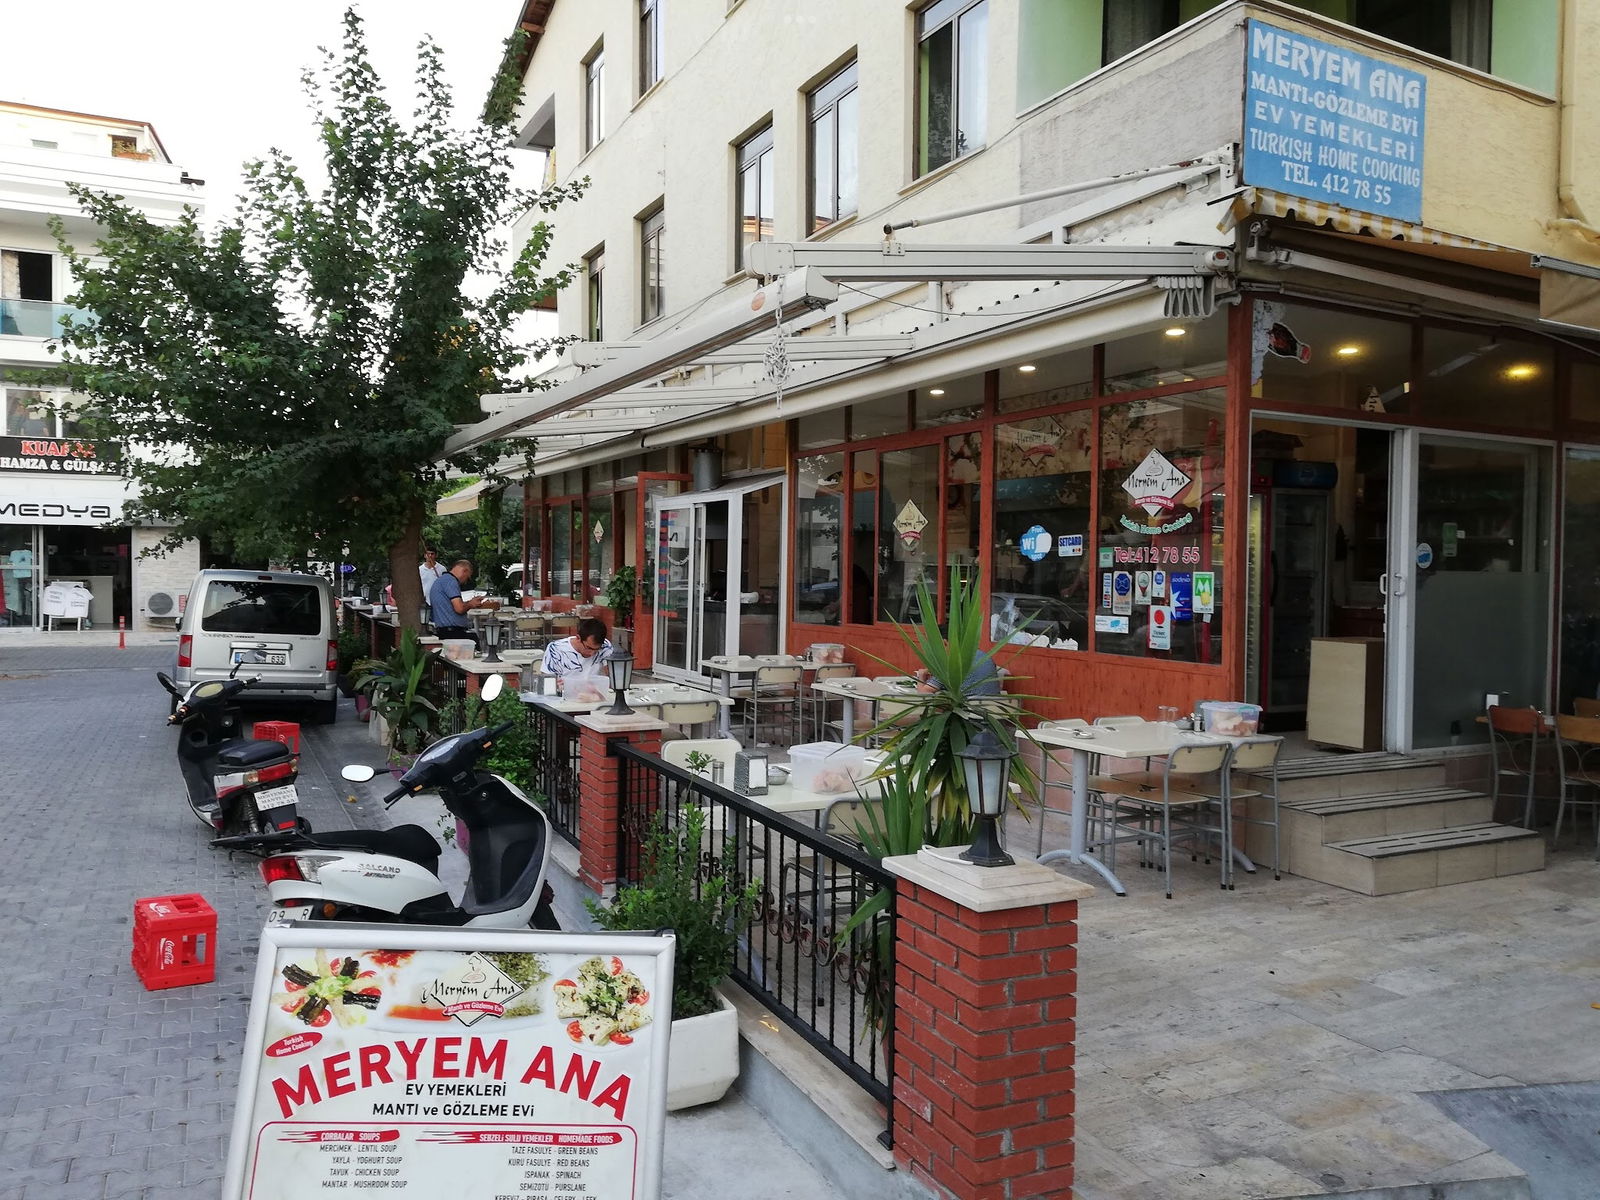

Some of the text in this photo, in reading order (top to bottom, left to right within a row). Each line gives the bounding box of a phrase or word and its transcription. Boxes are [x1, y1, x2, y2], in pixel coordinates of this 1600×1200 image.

[1252, 28, 1421, 109] MERYEM ANA
[1255, 100, 1415, 162] EV YEMEKLERİ
[1250, 128, 1421, 188] TURKISH HOME COOKING
[1281, 160, 1392, 205] TEL. 412 78 55
[0, 457, 48, 470] HAMZA
[1059, 536, 1082, 547] SETCARD
[1162, 546, 1179, 563] 78
[1182, 546, 1200, 563] 55
[420, 977, 515, 1004] Meryem Ana
[271, 1036, 632, 1122] MERYEM ANA
[405, 1081, 507, 1097] EV YEMEKLERİ
[372, 1103, 419, 1116] MANTI
[423, 1106, 438, 1116] ve
[443, 1100, 508, 1116] GÖZLEME
[358, 1132, 381, 1141] SOUPS
[505, 1134, 521, 1143] SULU
[522, 1134, 553, 1143] YEMEKLER
[558, 1135, 592, 1143] HOMEMADE
[593, 1135, 614, 1144] FOODS
[357, 1144, 379, 1152] LENTIL
[511, 1146, 599, 1155] TAZE FASULYE GREEN BEANS
[332, 1156, 403, 1164] YAYLA YOGHURT SOUP
[508, 1158, 590, 1167] KURU FASULYE RED BEANS
[329, 1168, 400, 1176] TAVUK CHICKEN SOUP
[524, 1171, 582, 1179] ISPANAK SPINACH
[321, 1180, 408, 1188] MANTAR MUSHROOM SOUP
[554, 1183, 586, 1191] PURSLANE
